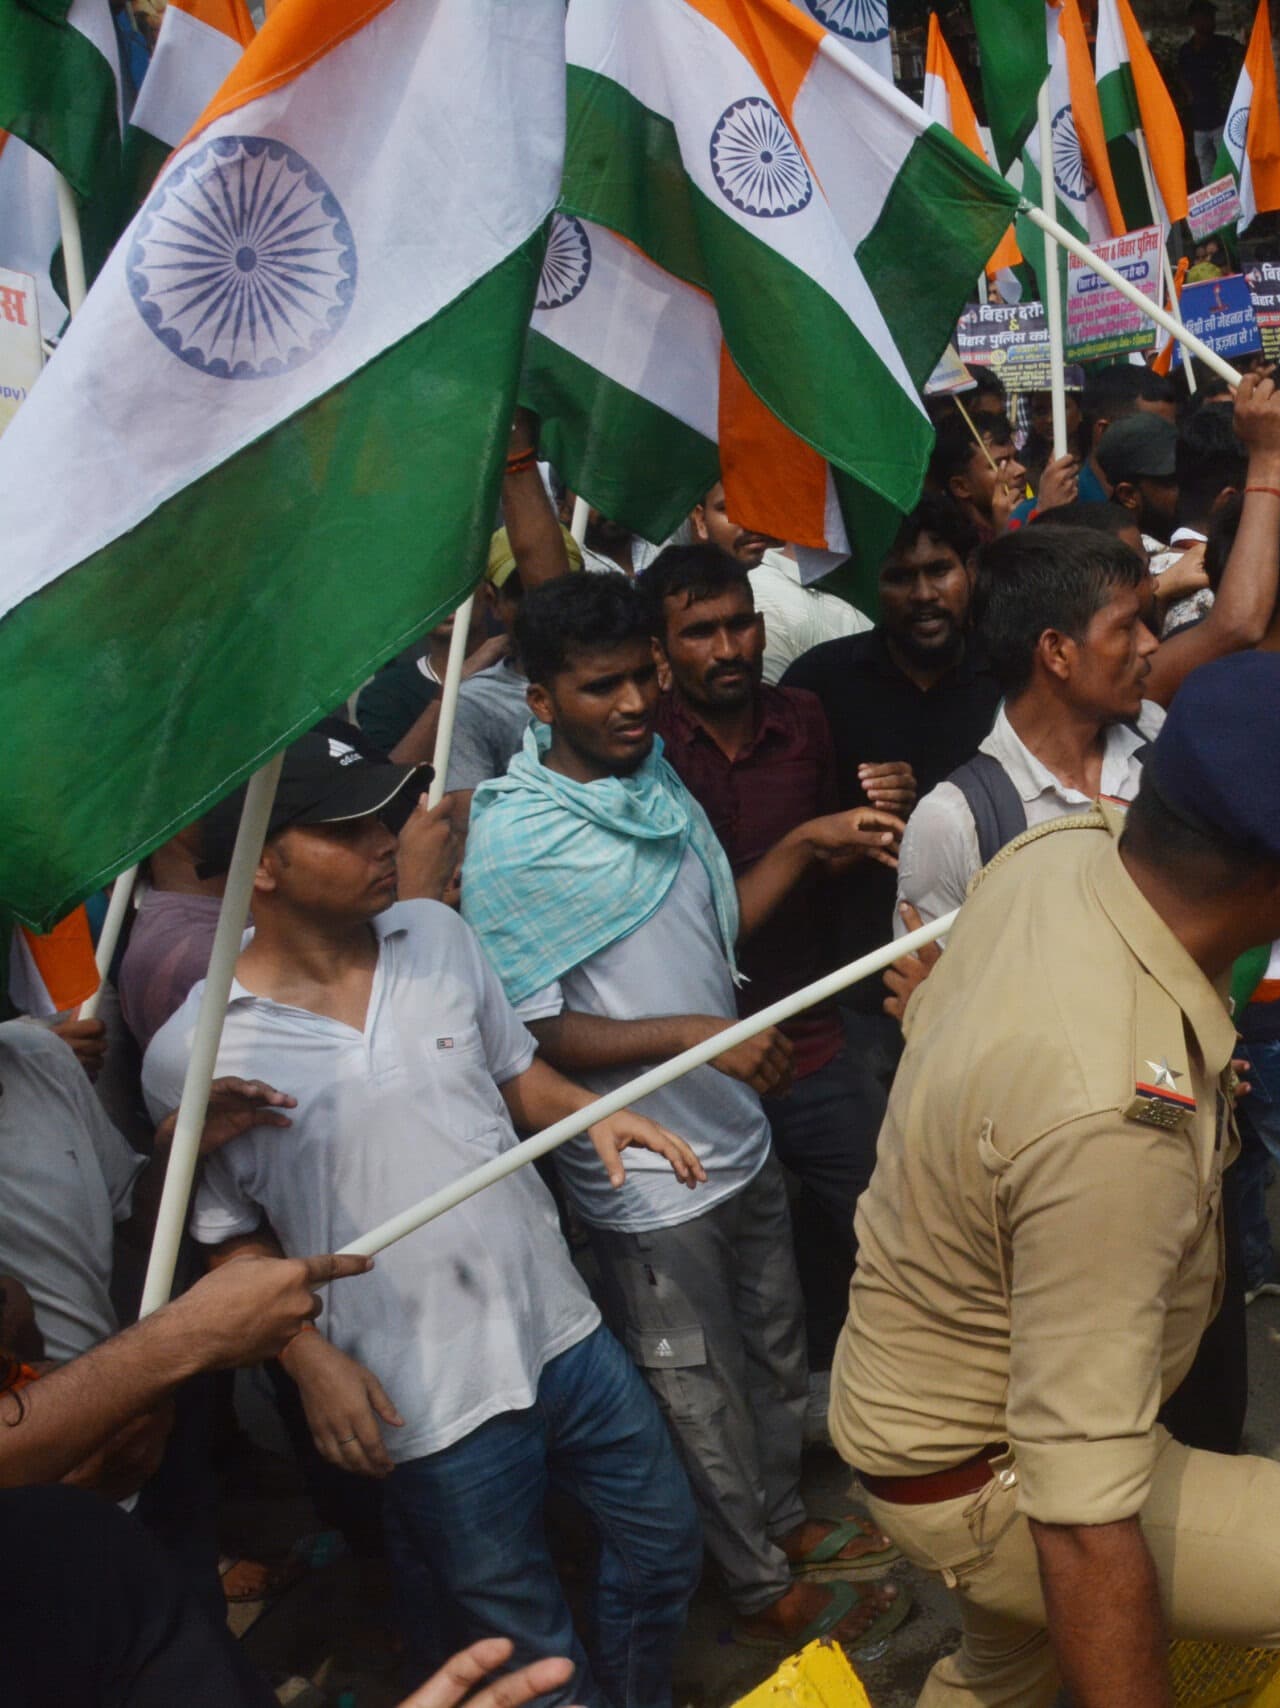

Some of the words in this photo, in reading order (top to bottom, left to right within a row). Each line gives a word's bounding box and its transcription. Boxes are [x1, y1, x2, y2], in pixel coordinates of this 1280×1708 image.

[979, 304, 1017, 323] बिहार
[1009, 319, 1020, 331] &
[1203, 314, 1221, 332] ली
[988, 330, 1027, 349] पुलिस
[1238, 327, 1248, 344] से
